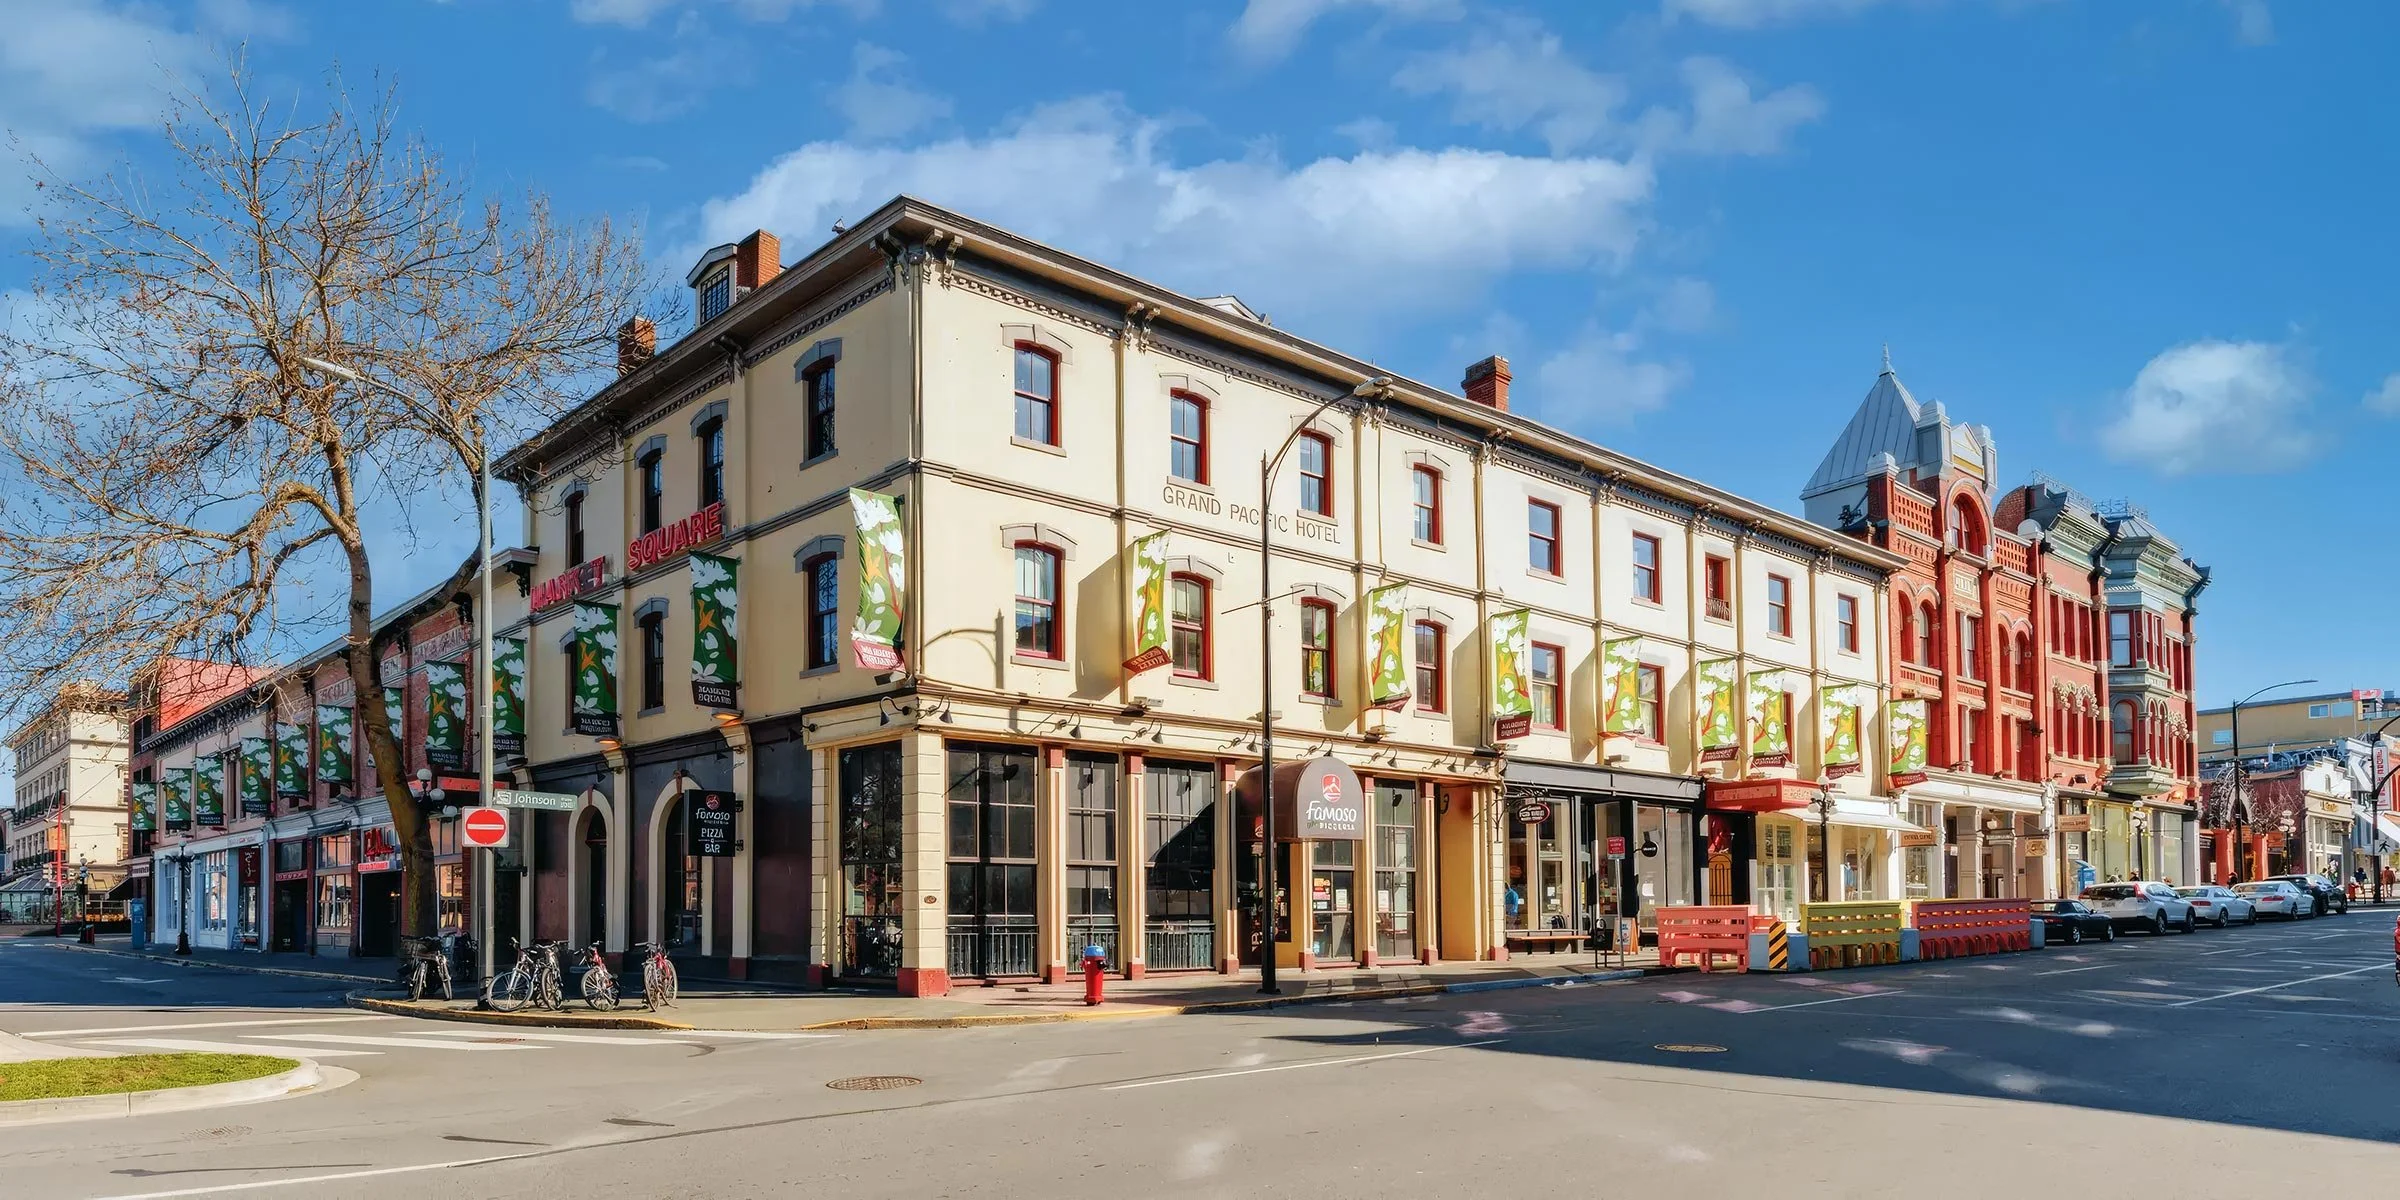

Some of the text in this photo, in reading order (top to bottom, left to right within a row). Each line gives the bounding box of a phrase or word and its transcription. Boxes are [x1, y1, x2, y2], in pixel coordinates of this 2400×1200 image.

[1163, 486, 1341, 545] GRAND PACIC HOTEL
[627, 502, 724, 571] SQUARE
[514, 793, 556, 806] Johnson
[701, 827, 724, 839] PIZZA
[704, 843, 721, 854] BAR
